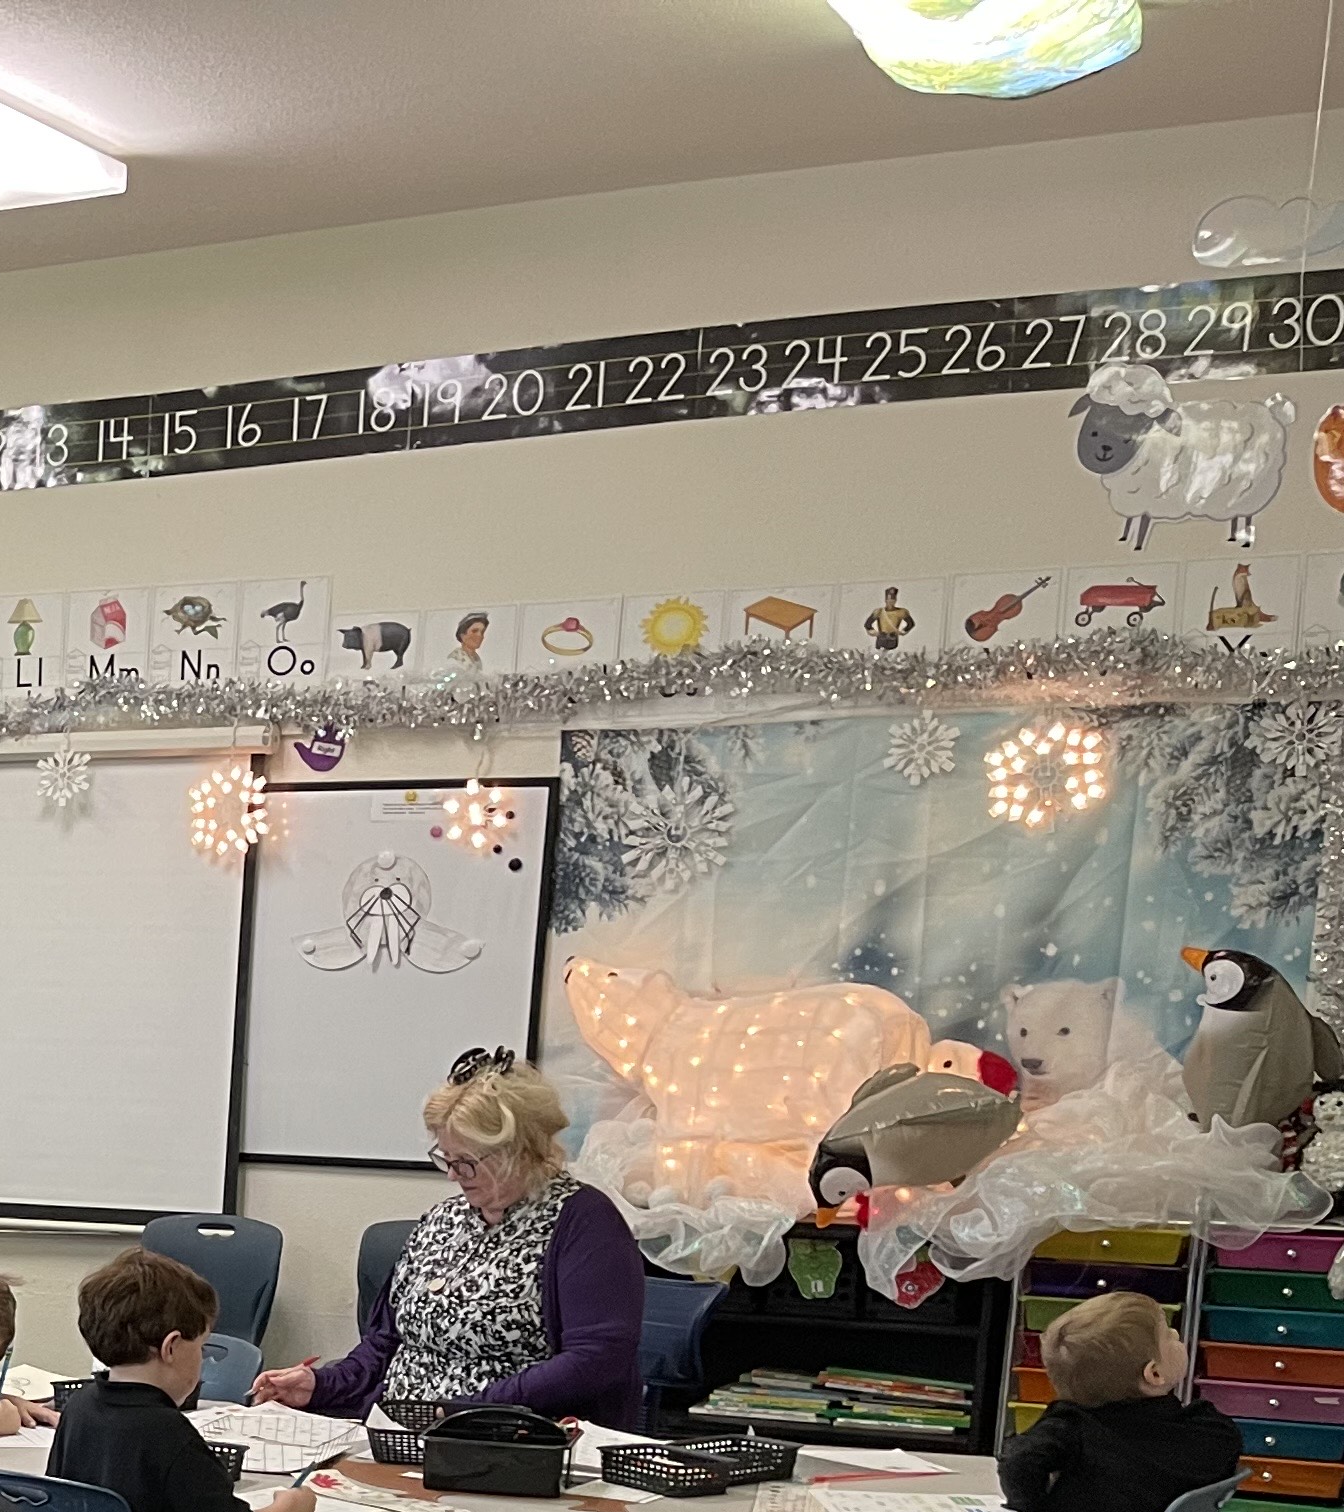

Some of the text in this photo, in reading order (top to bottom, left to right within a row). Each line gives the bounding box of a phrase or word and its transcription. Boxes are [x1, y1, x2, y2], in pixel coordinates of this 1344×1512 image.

[98, 418, 134, 461] 14
[163, 409, 198, 456] 15
[226, 403, 262, 449] 16
[292, 395, 329, 442] 17
[357, 388, 396, 435] 18
[422, 379, 462, 427] 19
[482, 369, 545, 421] 20
[565, 361, 606, 411] 21
[625, 353, 686, 405] 22
[706, 344, 768, 397] 23
[782, 335, 849, 389] 24
[861, 328, 928, 382] 25
[942, 322, 1006, 376] 26
[1022, 315, 1086, 369] 27
[1099, 309, 1167, 363] 28
[1183, 301, 1257, 357] 29
[1268, 293, 1344, 350] 30
[16, 656, 43, 688] Ll
[89, 653, 140, 681] Mm
[181, 649, 220, 681] Nn
[267, 645, 315, 676] Oo
